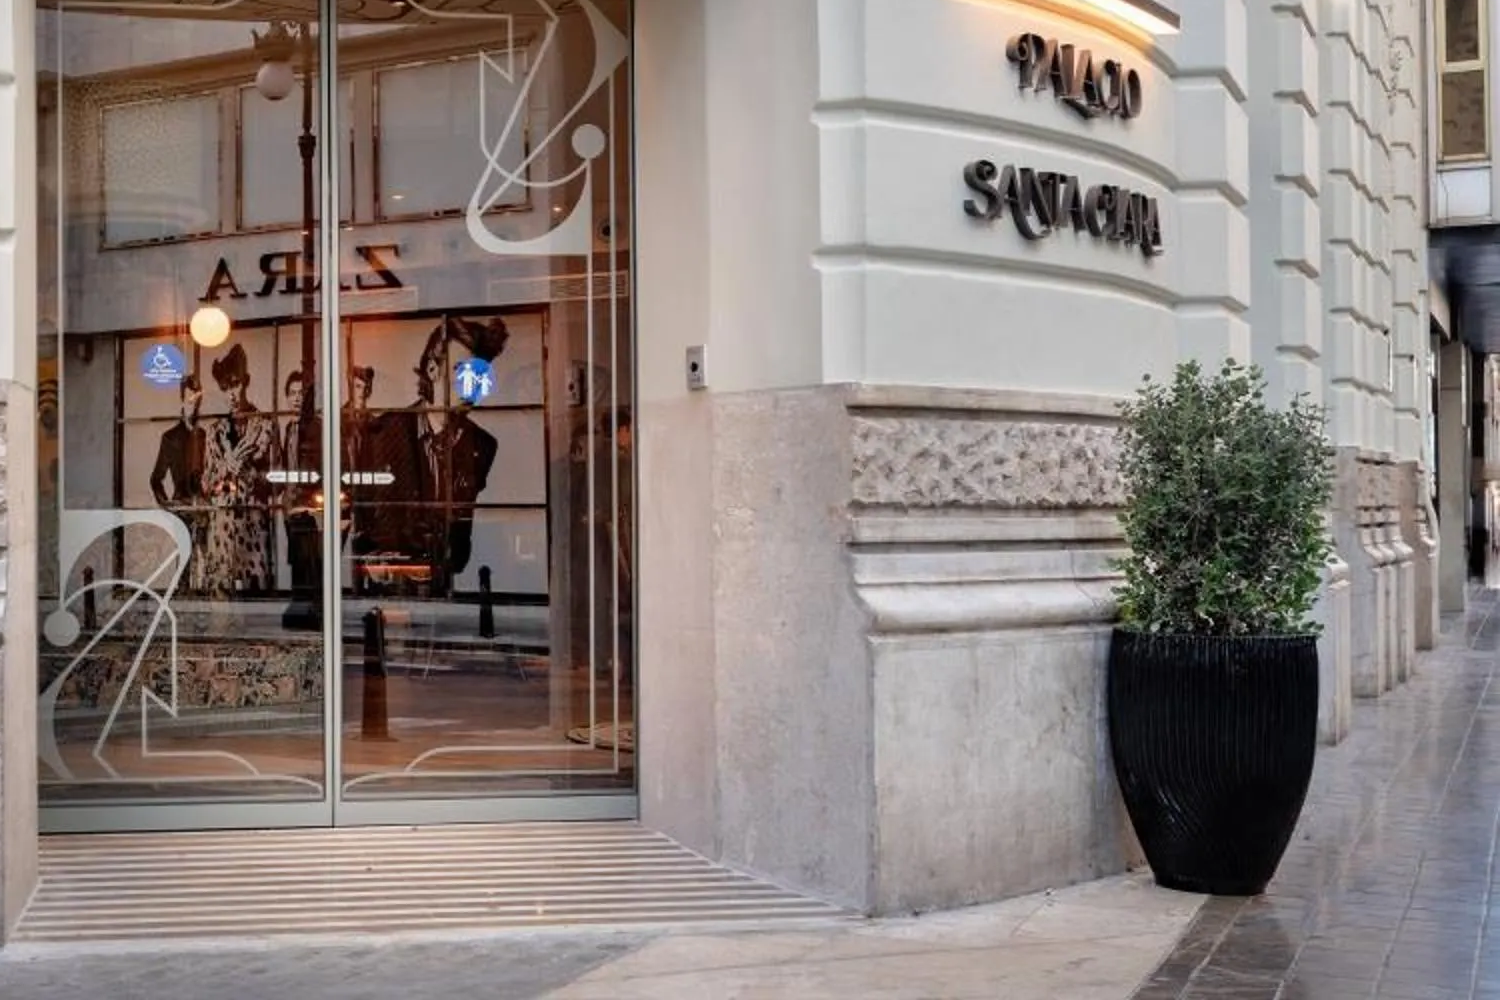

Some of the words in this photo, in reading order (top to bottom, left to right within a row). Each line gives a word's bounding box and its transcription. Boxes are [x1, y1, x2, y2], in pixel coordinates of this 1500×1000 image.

[1005, 31, 1143, 121] PALACIO
[963, 159, 1088, 241] SANTA
[1084, 183, 1164, 258] CLARA
